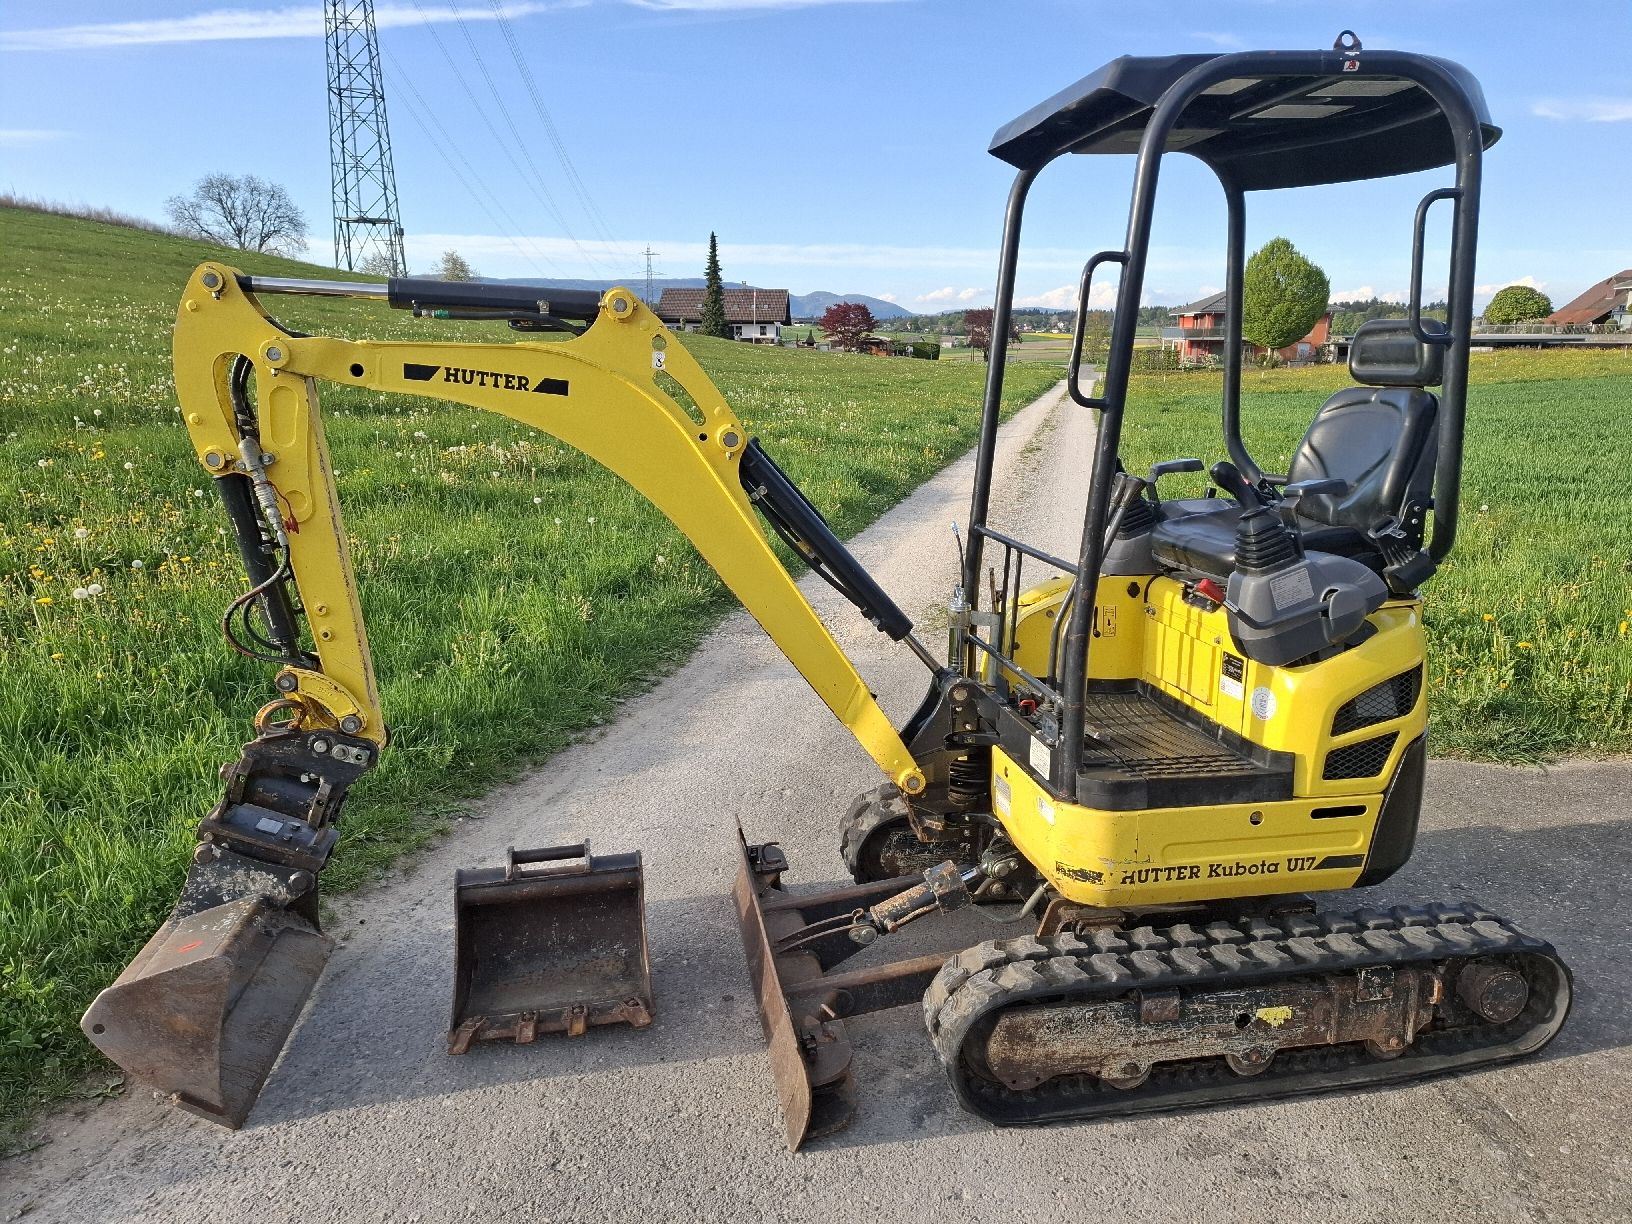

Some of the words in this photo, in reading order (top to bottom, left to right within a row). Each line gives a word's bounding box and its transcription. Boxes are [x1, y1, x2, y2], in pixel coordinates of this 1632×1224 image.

[444, 367, 529, 391] HUTTER
[1120, 865, 1200, 884] HUTTER
[1207, 860, 1280, 878] Kubota
[1287, 856, 1316, 872] U17
